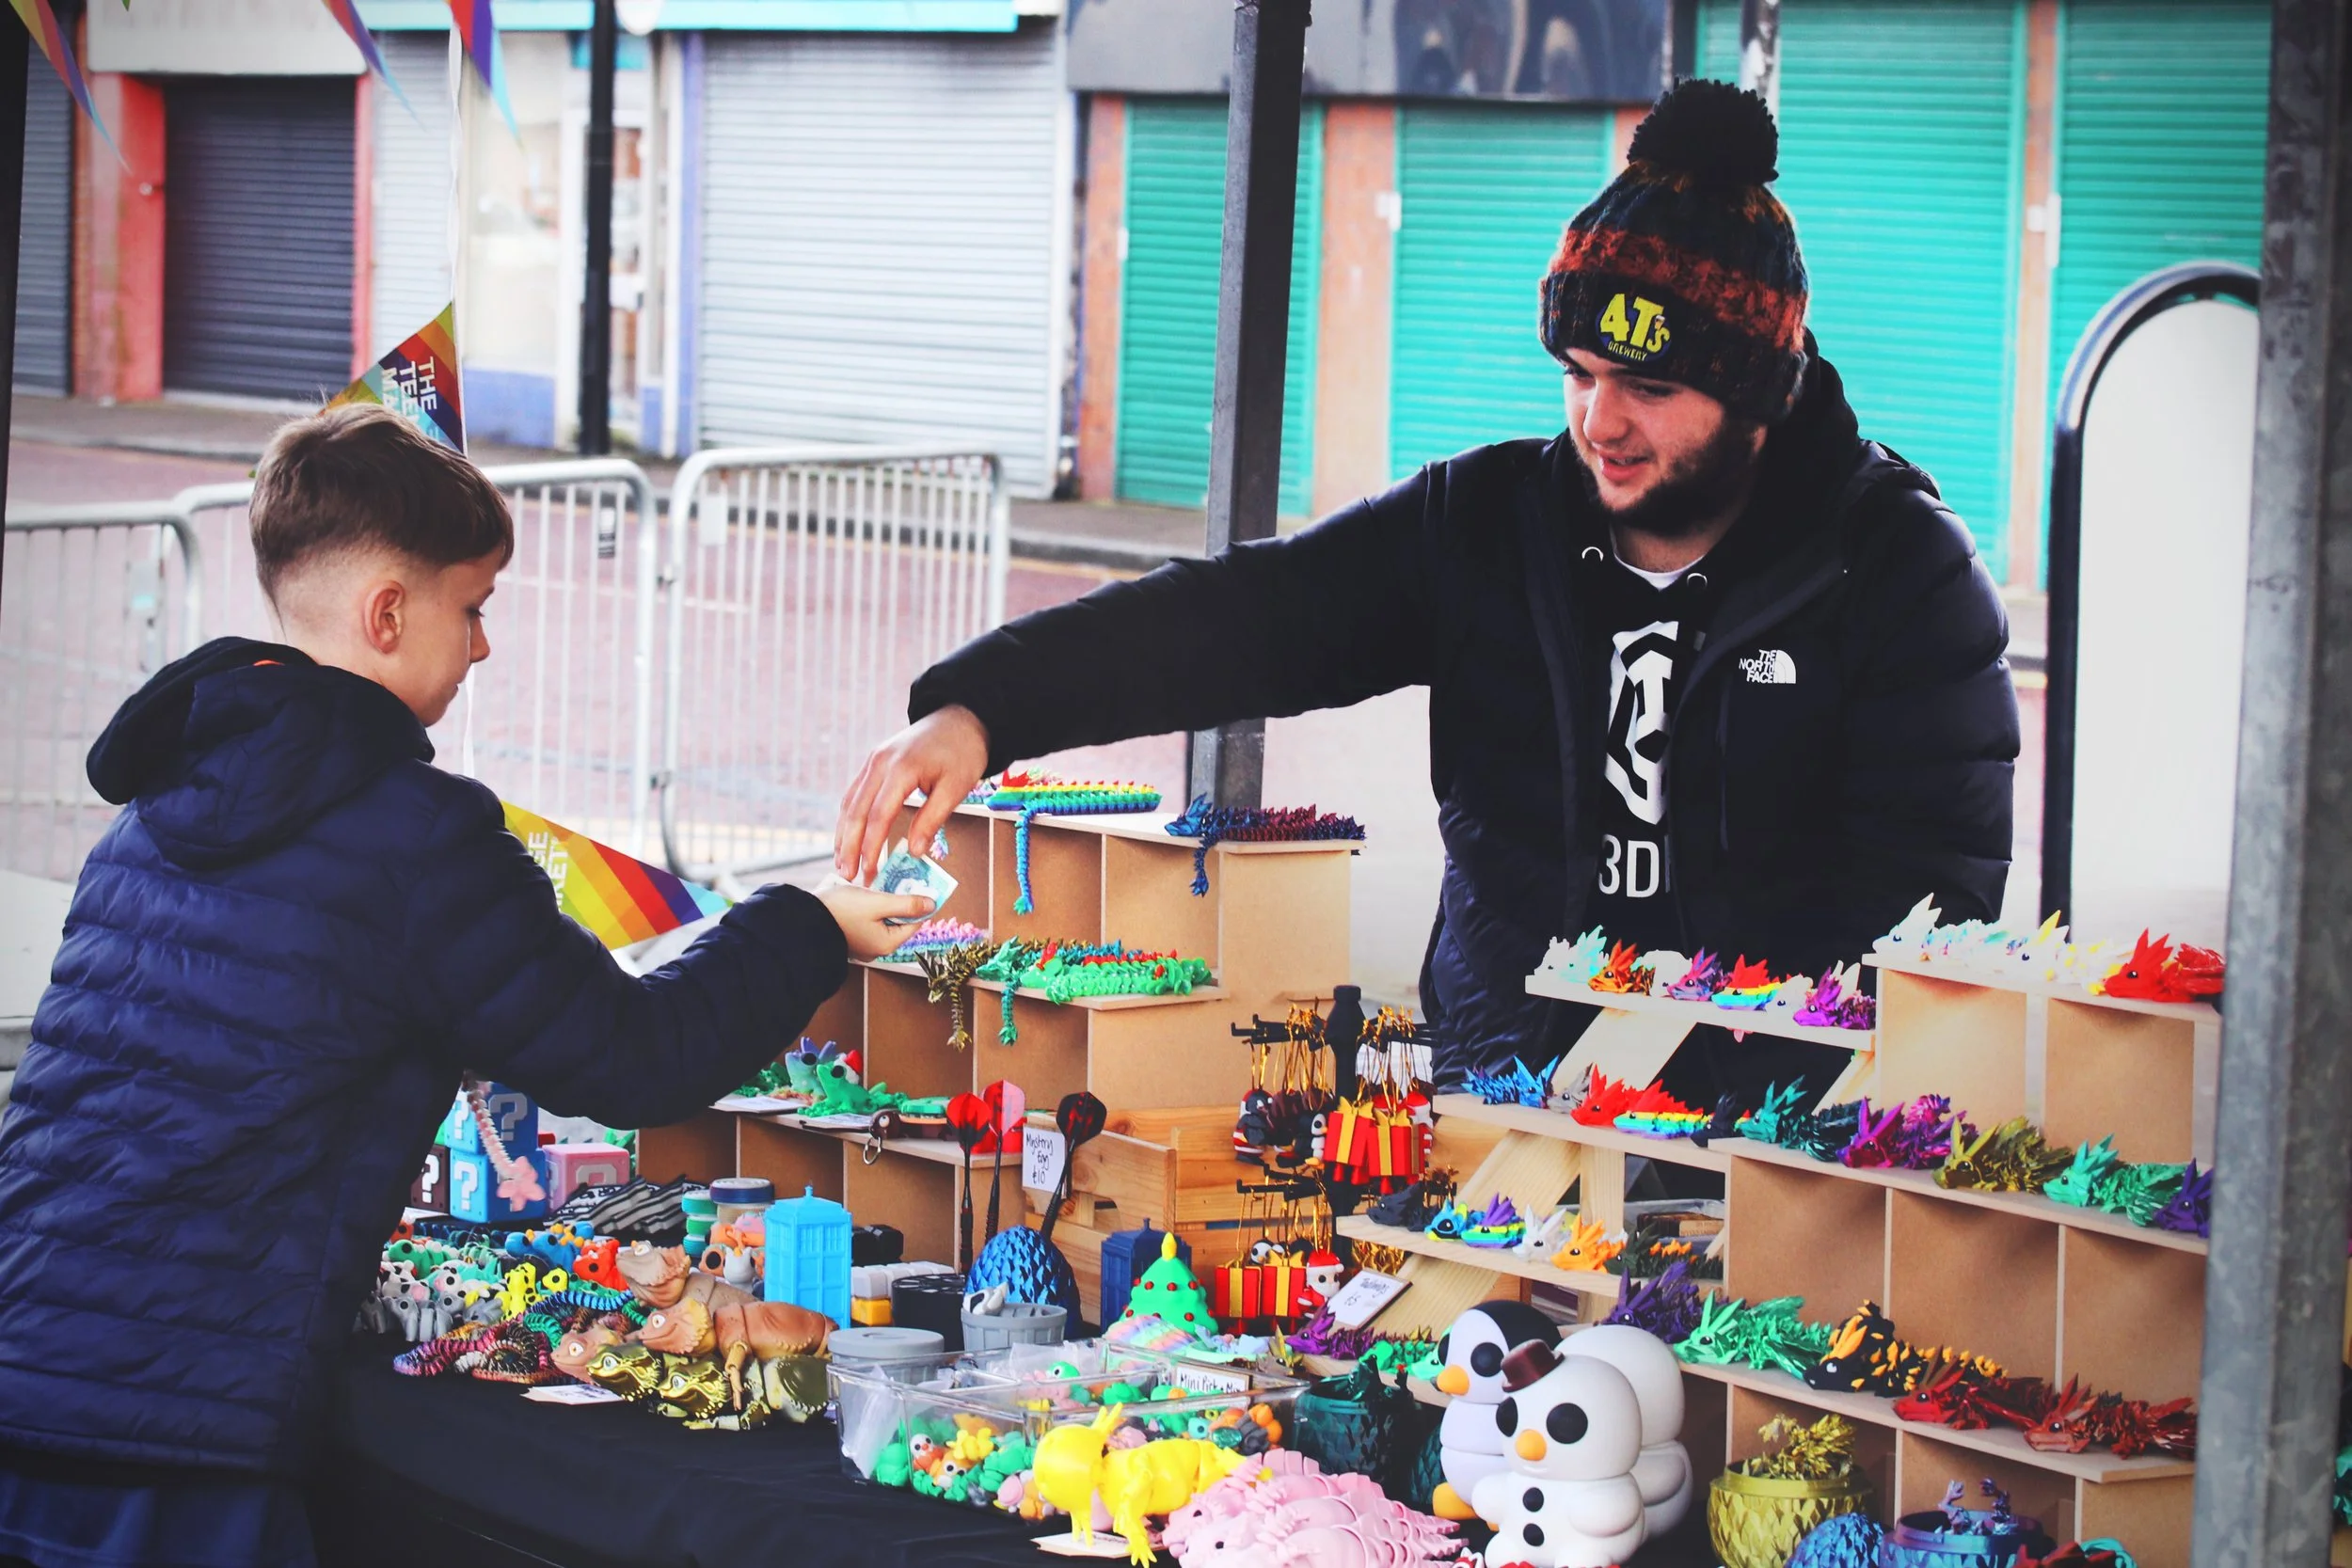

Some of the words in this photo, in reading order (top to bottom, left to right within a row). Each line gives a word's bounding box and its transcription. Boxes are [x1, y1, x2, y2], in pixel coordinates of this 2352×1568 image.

[1607, 341, 1647, 361] BREWERY
[382, 367, 399, 408] MA
[419, 356, 437, 411] THE
[1759, 649, 1776, 662] THE
[1739, 658, 1775, 674] NORTH
[1746, 670, 1773, 684] FACE
[1180, 1372, 1200, 1391] Mini
